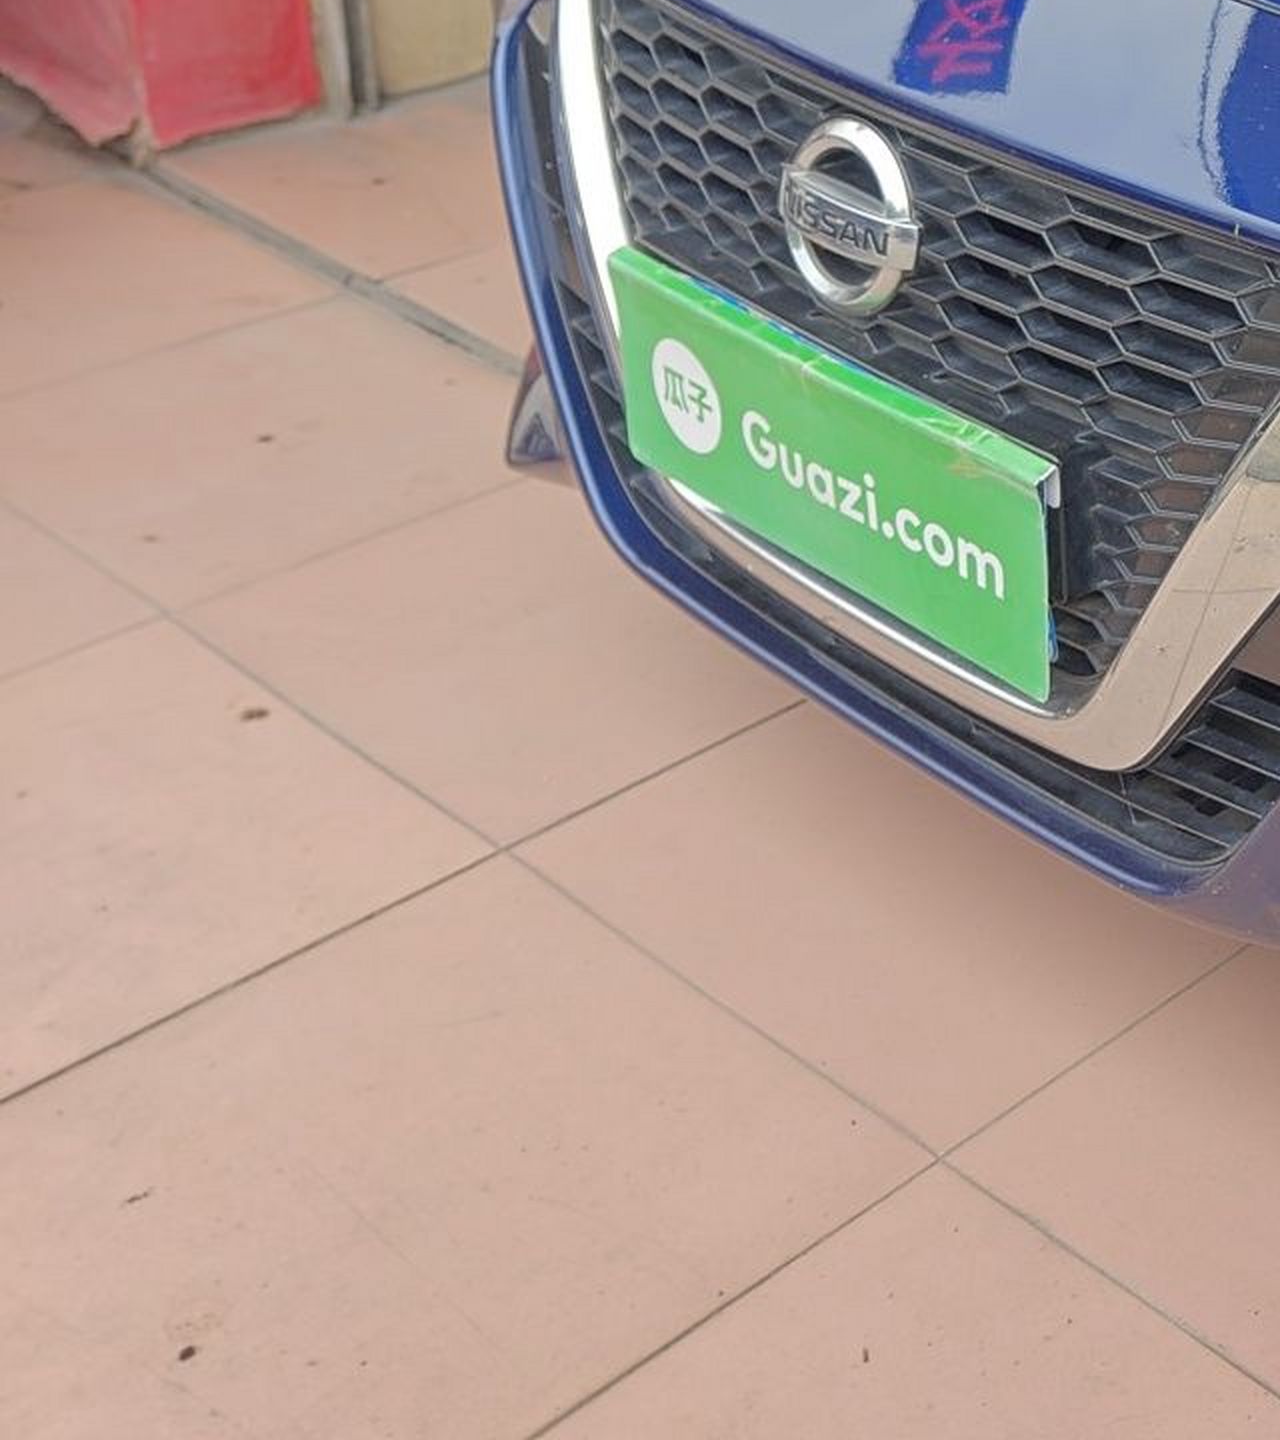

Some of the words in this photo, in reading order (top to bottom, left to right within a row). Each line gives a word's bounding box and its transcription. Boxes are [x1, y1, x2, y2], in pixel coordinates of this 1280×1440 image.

[784, 181, 889, 257] NISSAN
[664, 366, 713, 423] 瓜子
[741, 410, 1005, 600] Guazi.com
